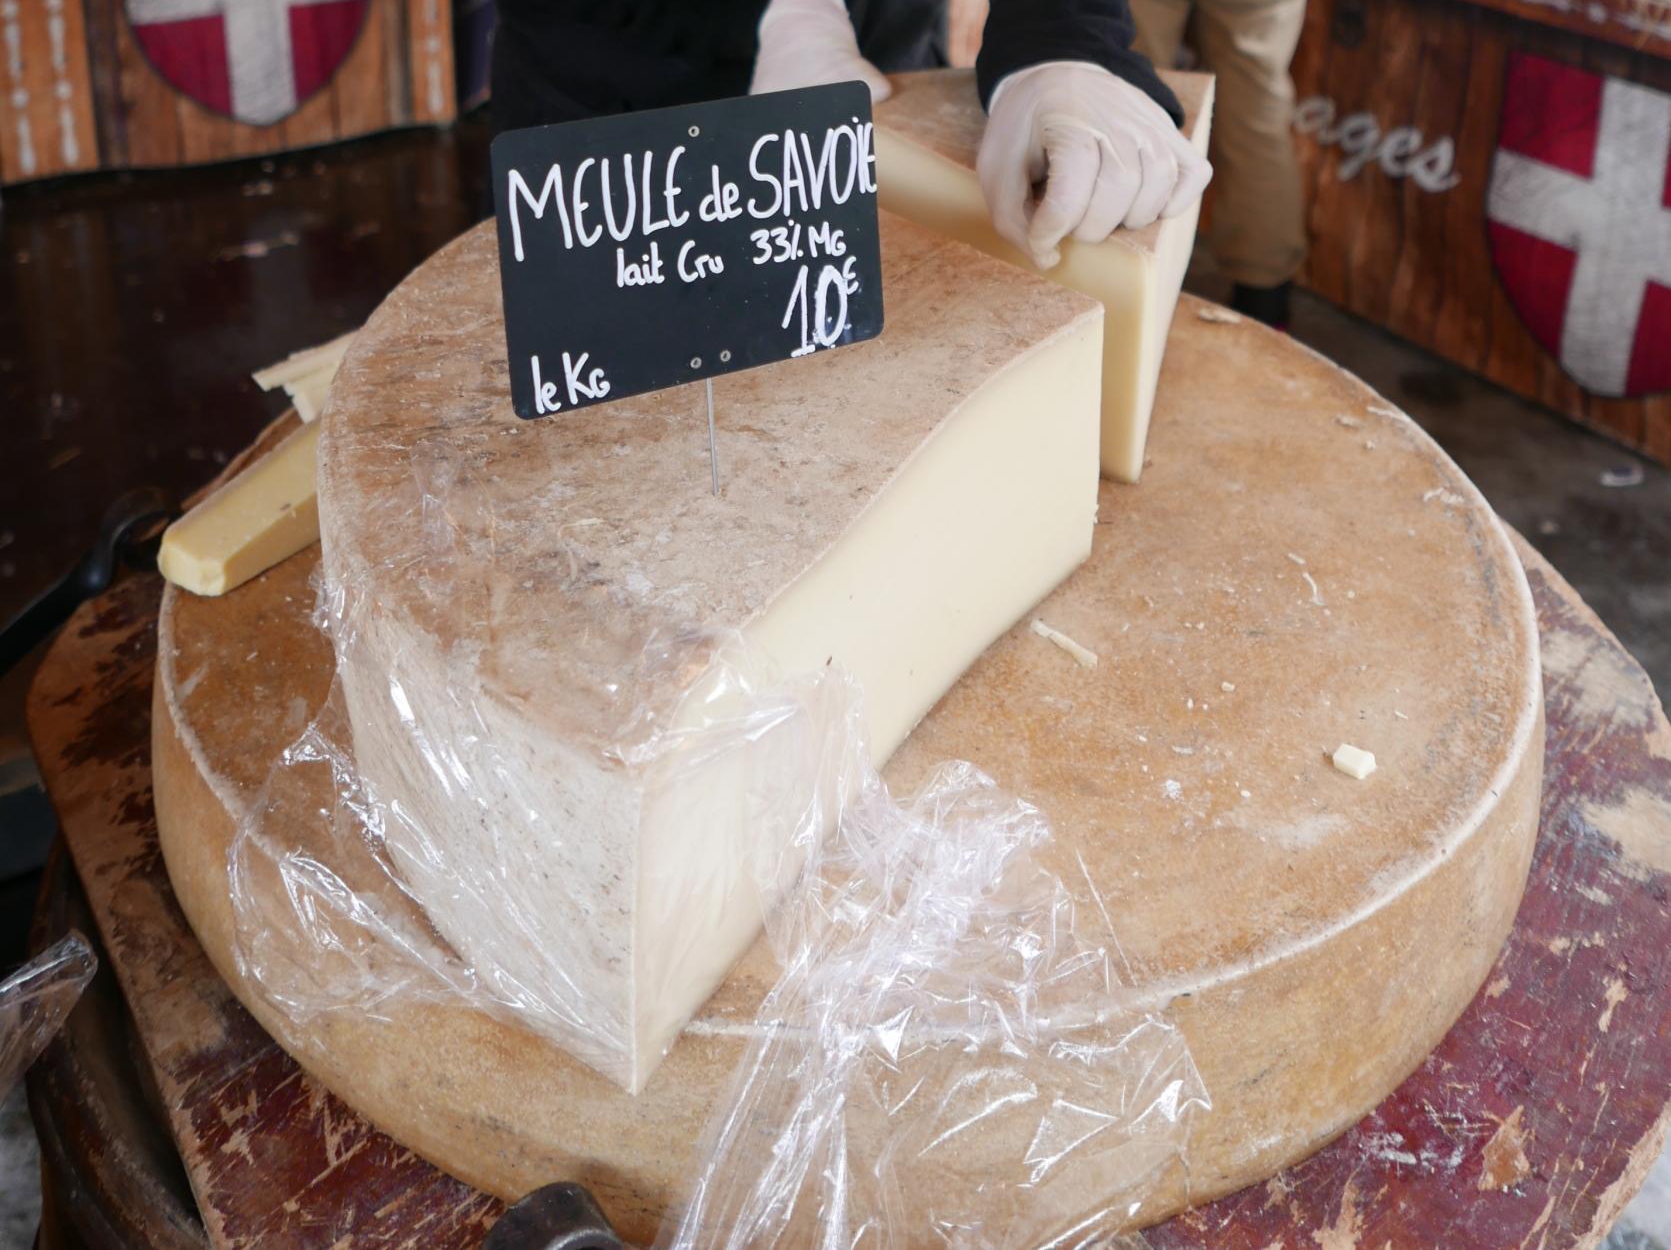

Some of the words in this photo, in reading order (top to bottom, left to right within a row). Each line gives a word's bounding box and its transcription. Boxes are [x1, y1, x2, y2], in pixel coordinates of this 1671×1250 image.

[508, 145, 691, 262] MEULE
[698, 163, 743, 223] de
[616, 240, 666, 289] lait
[677, 239, 725, 284] Cru
[750, 218, 805, 265] 33%
[530, 354, 562, 415] le
